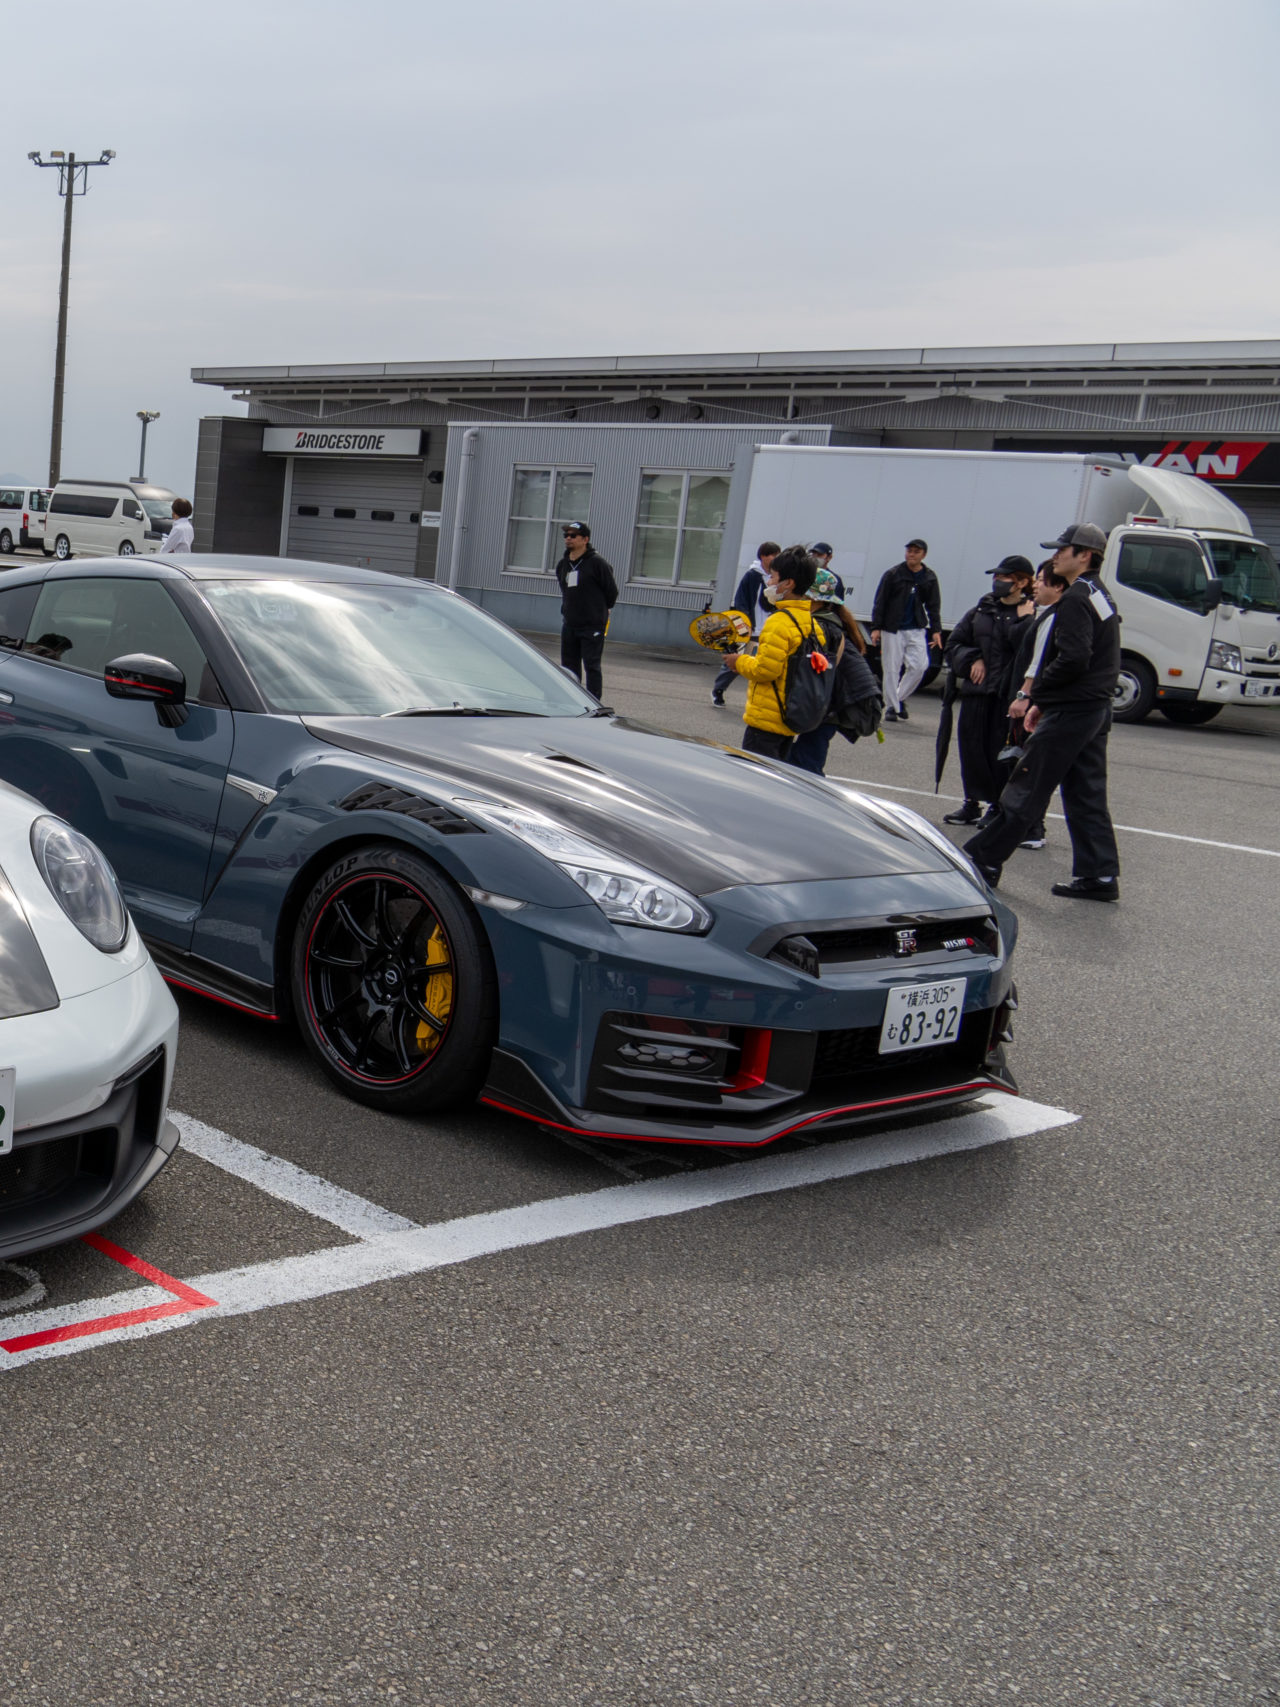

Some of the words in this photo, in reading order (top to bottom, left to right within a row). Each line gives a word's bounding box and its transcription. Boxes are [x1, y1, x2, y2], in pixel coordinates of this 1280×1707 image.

[295, 432, 385, 450] BRIDGESTONE
[1090, 452, 1239, 475] VAN
[300, 856, 359, 926] DUNLOP
[899, 1005, 958, 1045] 83-92
